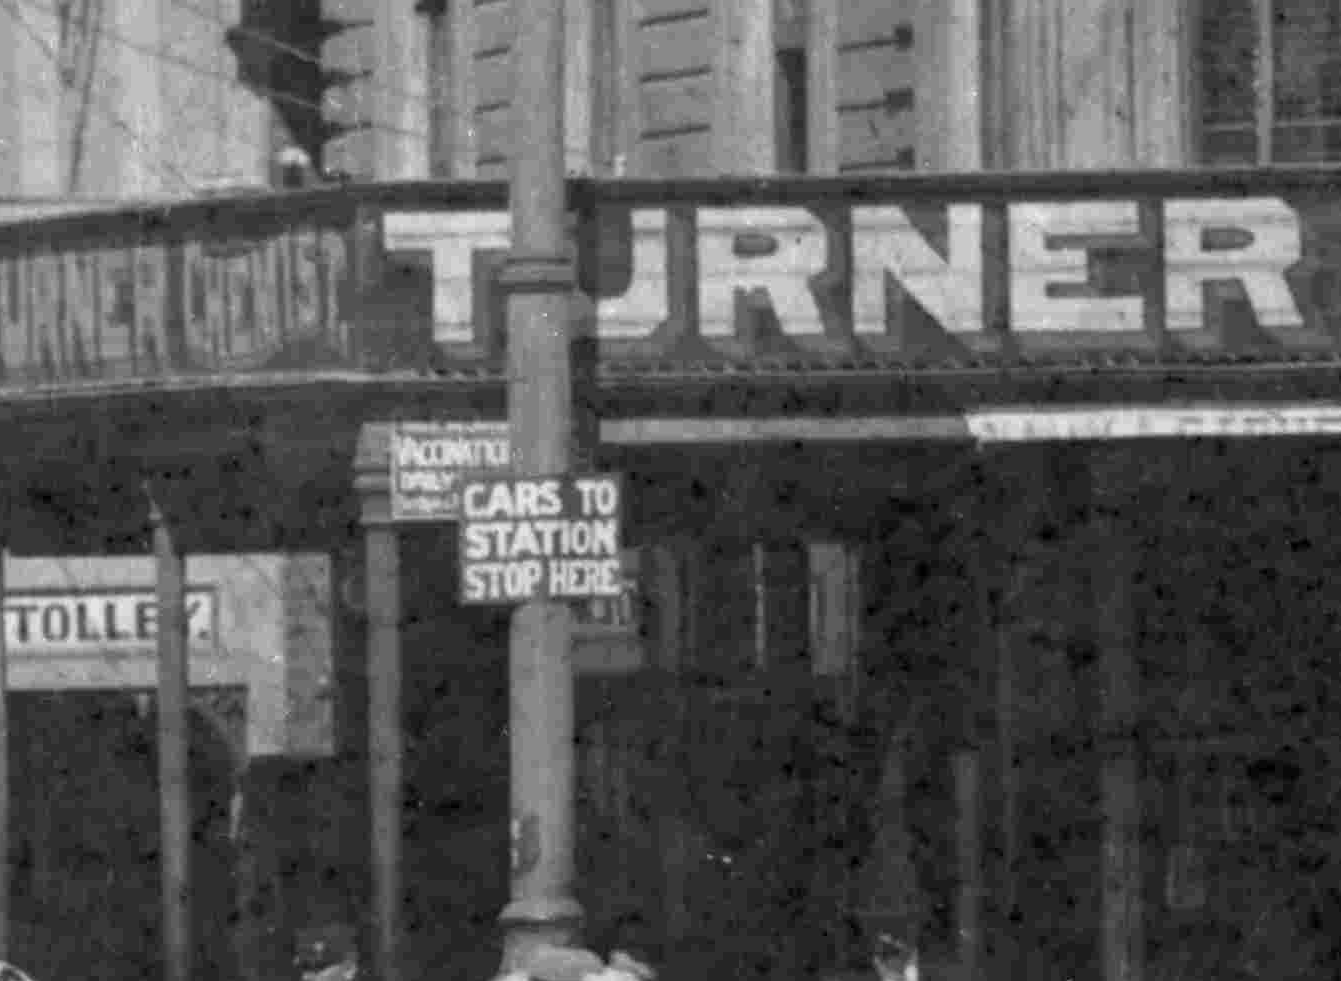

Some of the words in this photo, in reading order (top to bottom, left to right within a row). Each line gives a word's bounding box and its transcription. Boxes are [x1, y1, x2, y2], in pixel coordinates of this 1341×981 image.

[382, 199, 1304, 342] TURNER
[463, 481, 563, 518] CARS
[575, 479, 617, 516] TO
[465, 519, 617, 560] STATION
[465, 560, 543, 600] STOP
